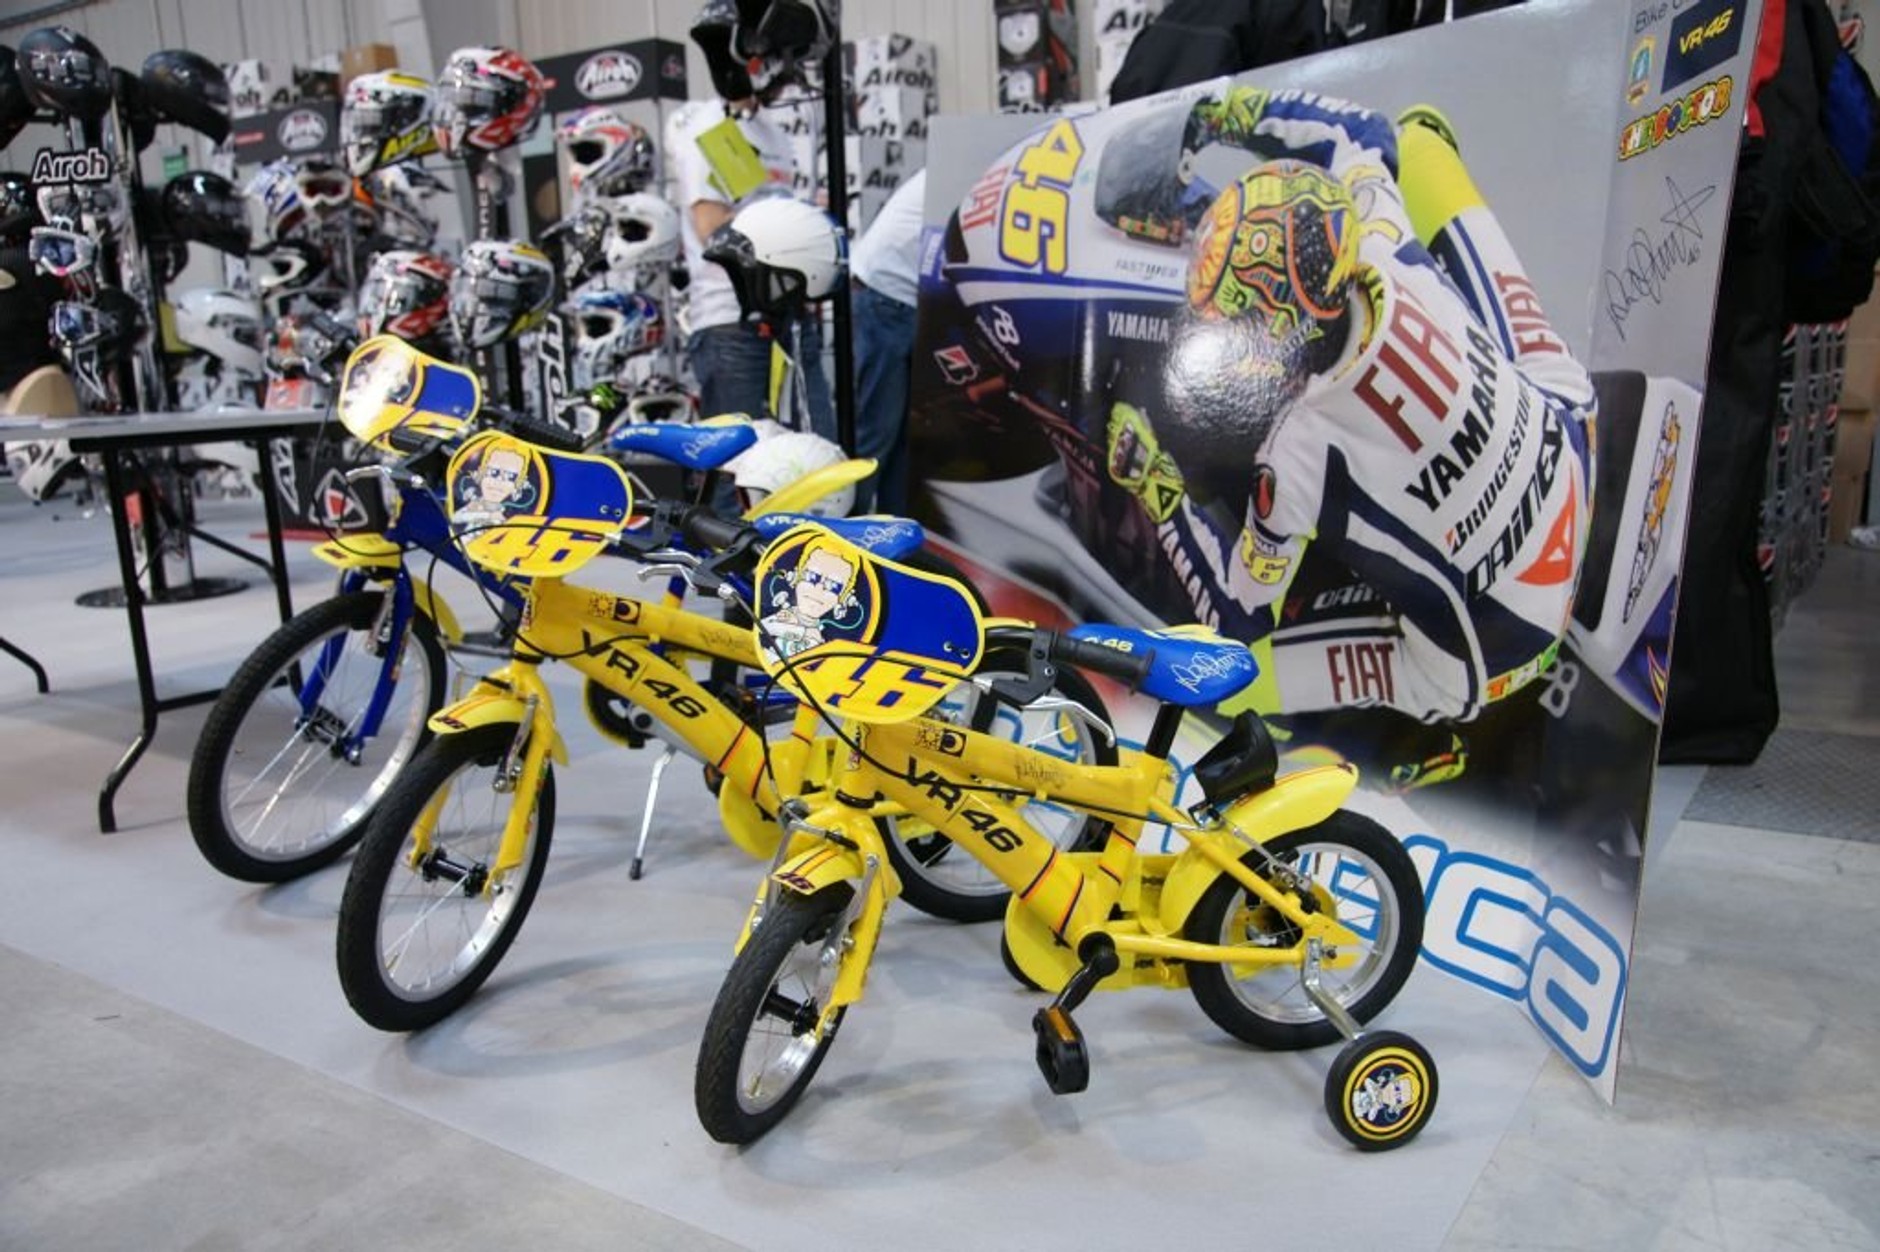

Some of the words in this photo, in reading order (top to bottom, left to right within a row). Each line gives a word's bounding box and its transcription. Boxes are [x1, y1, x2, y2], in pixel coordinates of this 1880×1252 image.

[863, 67, 934, 89] Airoh
[34, 149, 108, 182] Airoh
[999, 118, 1085, 276] 46
[1107, 310, 1170, 347] YAMAHA
[1494, 270, 1563, 354] FIAT
[1404, 326, 1498, 512] YAMAHA
[467, 514, 622, 573] 46
[1157, 519, 1219, 632] YAMAHA
[641, 678, 708, 719] 46
[776, 638, 966, 714] 46
[1327, 643, 1396, 704] FIAT
[961, 809, 1024, 853] 46
